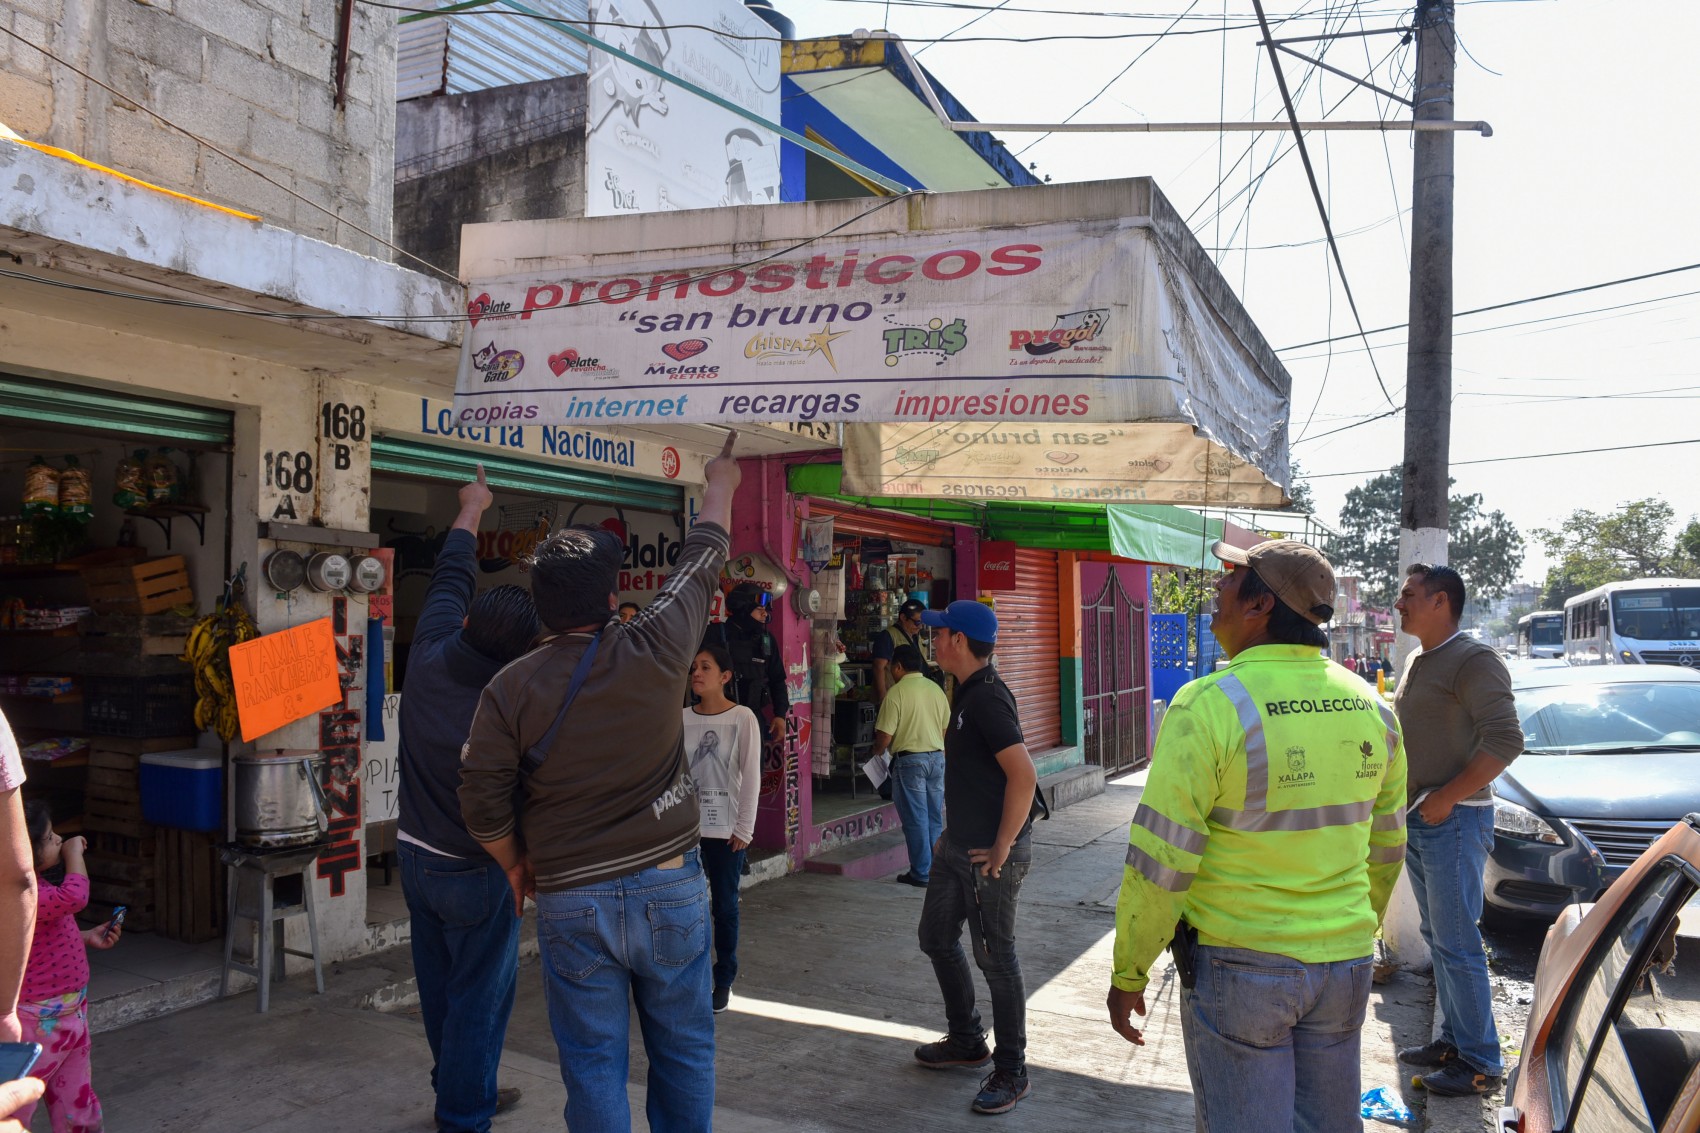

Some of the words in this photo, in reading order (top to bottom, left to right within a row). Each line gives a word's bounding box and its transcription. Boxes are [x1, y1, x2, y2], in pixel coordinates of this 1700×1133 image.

[520, 243, 1044, 320] pronosticos
[1009, 321, 1101, 351] progol
[644, 364, 721, 375] Melate
[668, 372, 719, 380] RETRO
[459, 401, 540, 425] copias
[565, 394, 688, 419] internet
[718, 391, 861, 421] recargas
[894, 387, 1091, 422] impresiones
[322, 402, 366, 442] 168
[541, 425, 635, 468] Nacional
[263, 450, 314, 494] 168
[1265, 694, 1374, 717] RECOLECCIÓN
[1278, 771, 1315, 783] XALAPA
[1355, 769, 1378, 779] Xalapa
[822, 811, 884, 841] COPIAS
